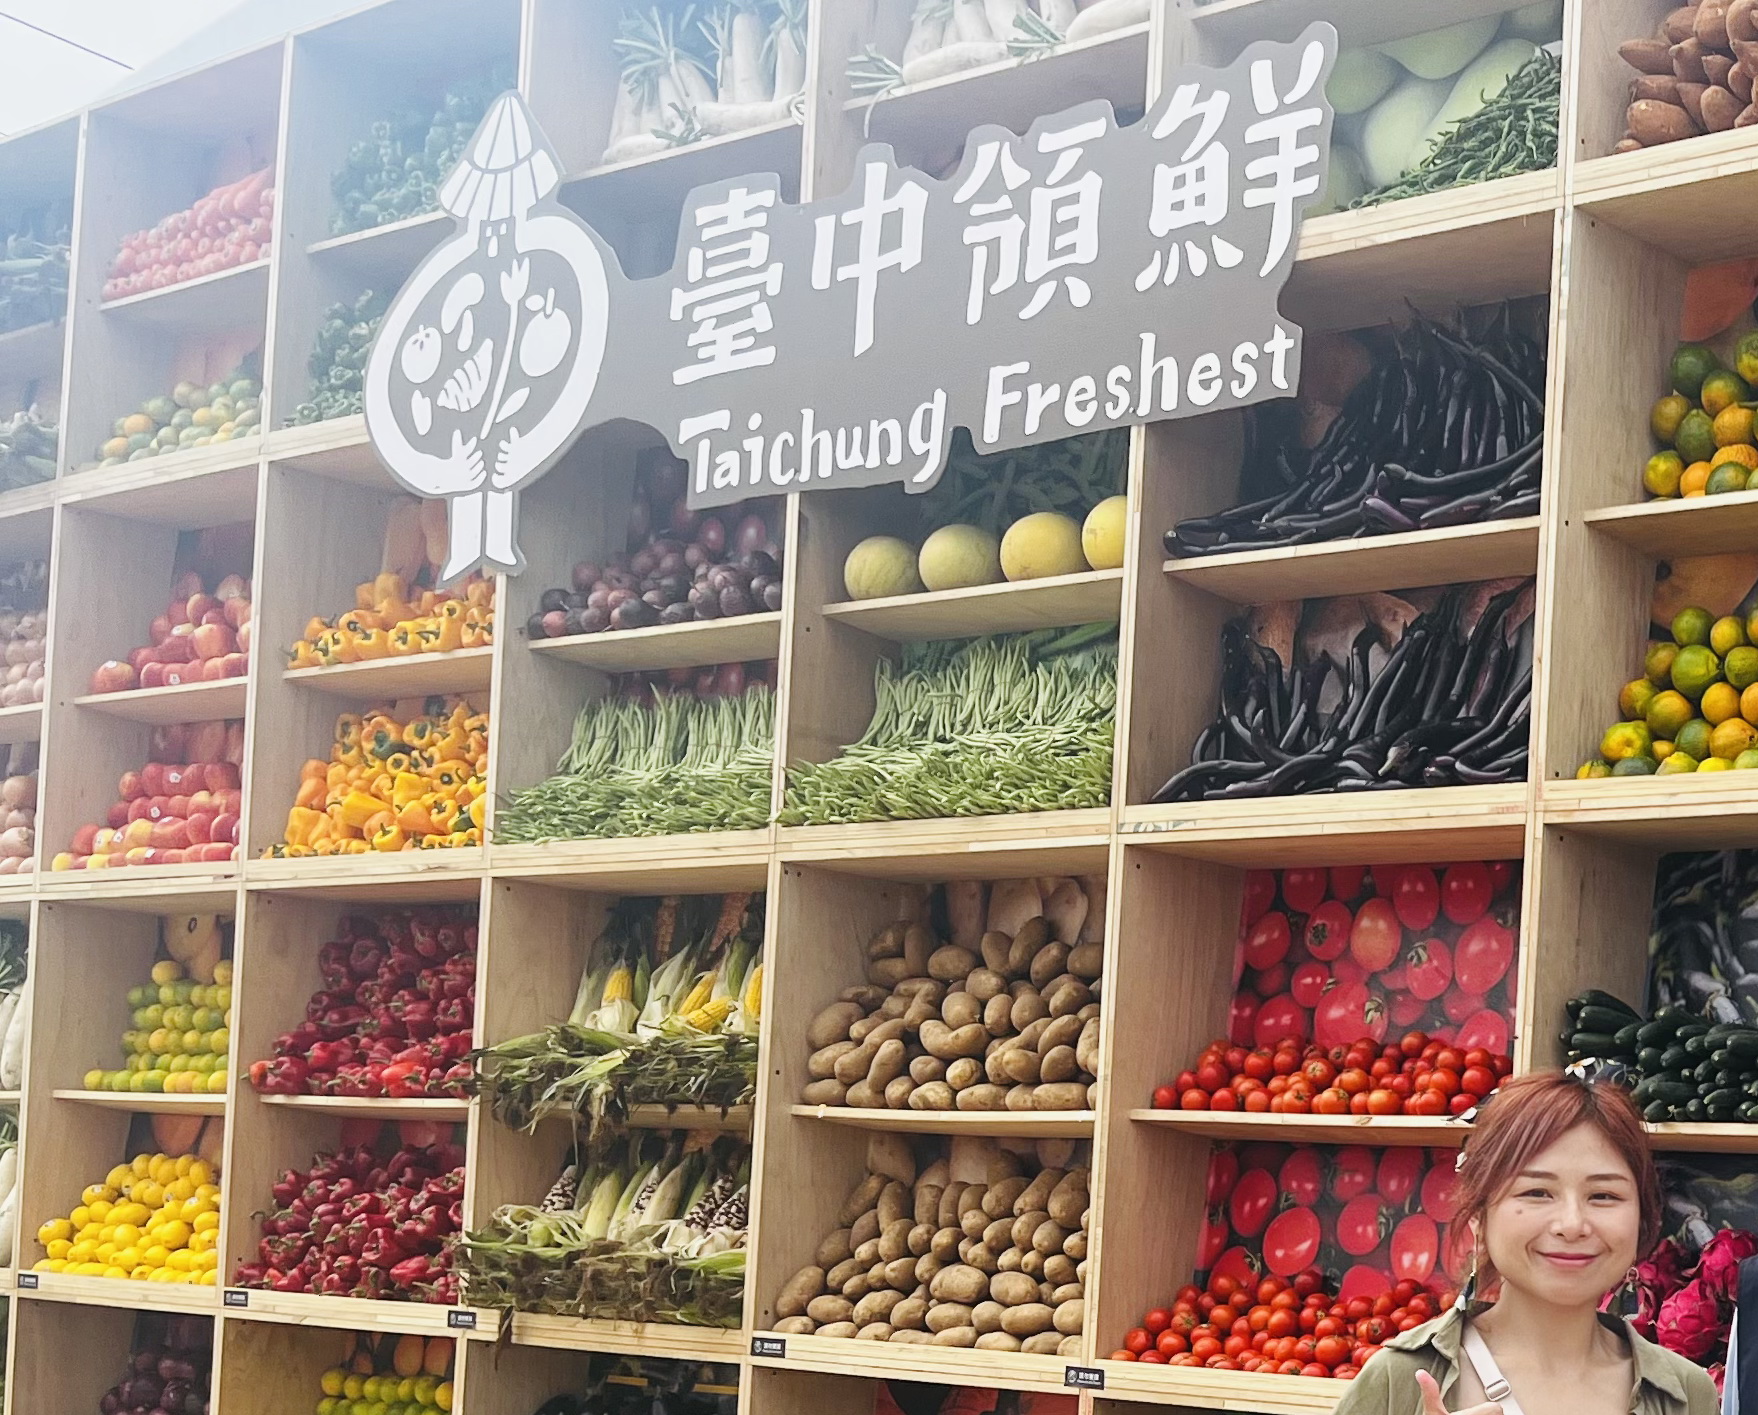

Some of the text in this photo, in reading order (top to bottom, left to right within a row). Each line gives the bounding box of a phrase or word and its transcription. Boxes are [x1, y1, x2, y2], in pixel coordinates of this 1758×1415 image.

[669, 41, 1325, 386] 臺中領鮮
[678, 325, 1295, 494] Taichung Freshest
